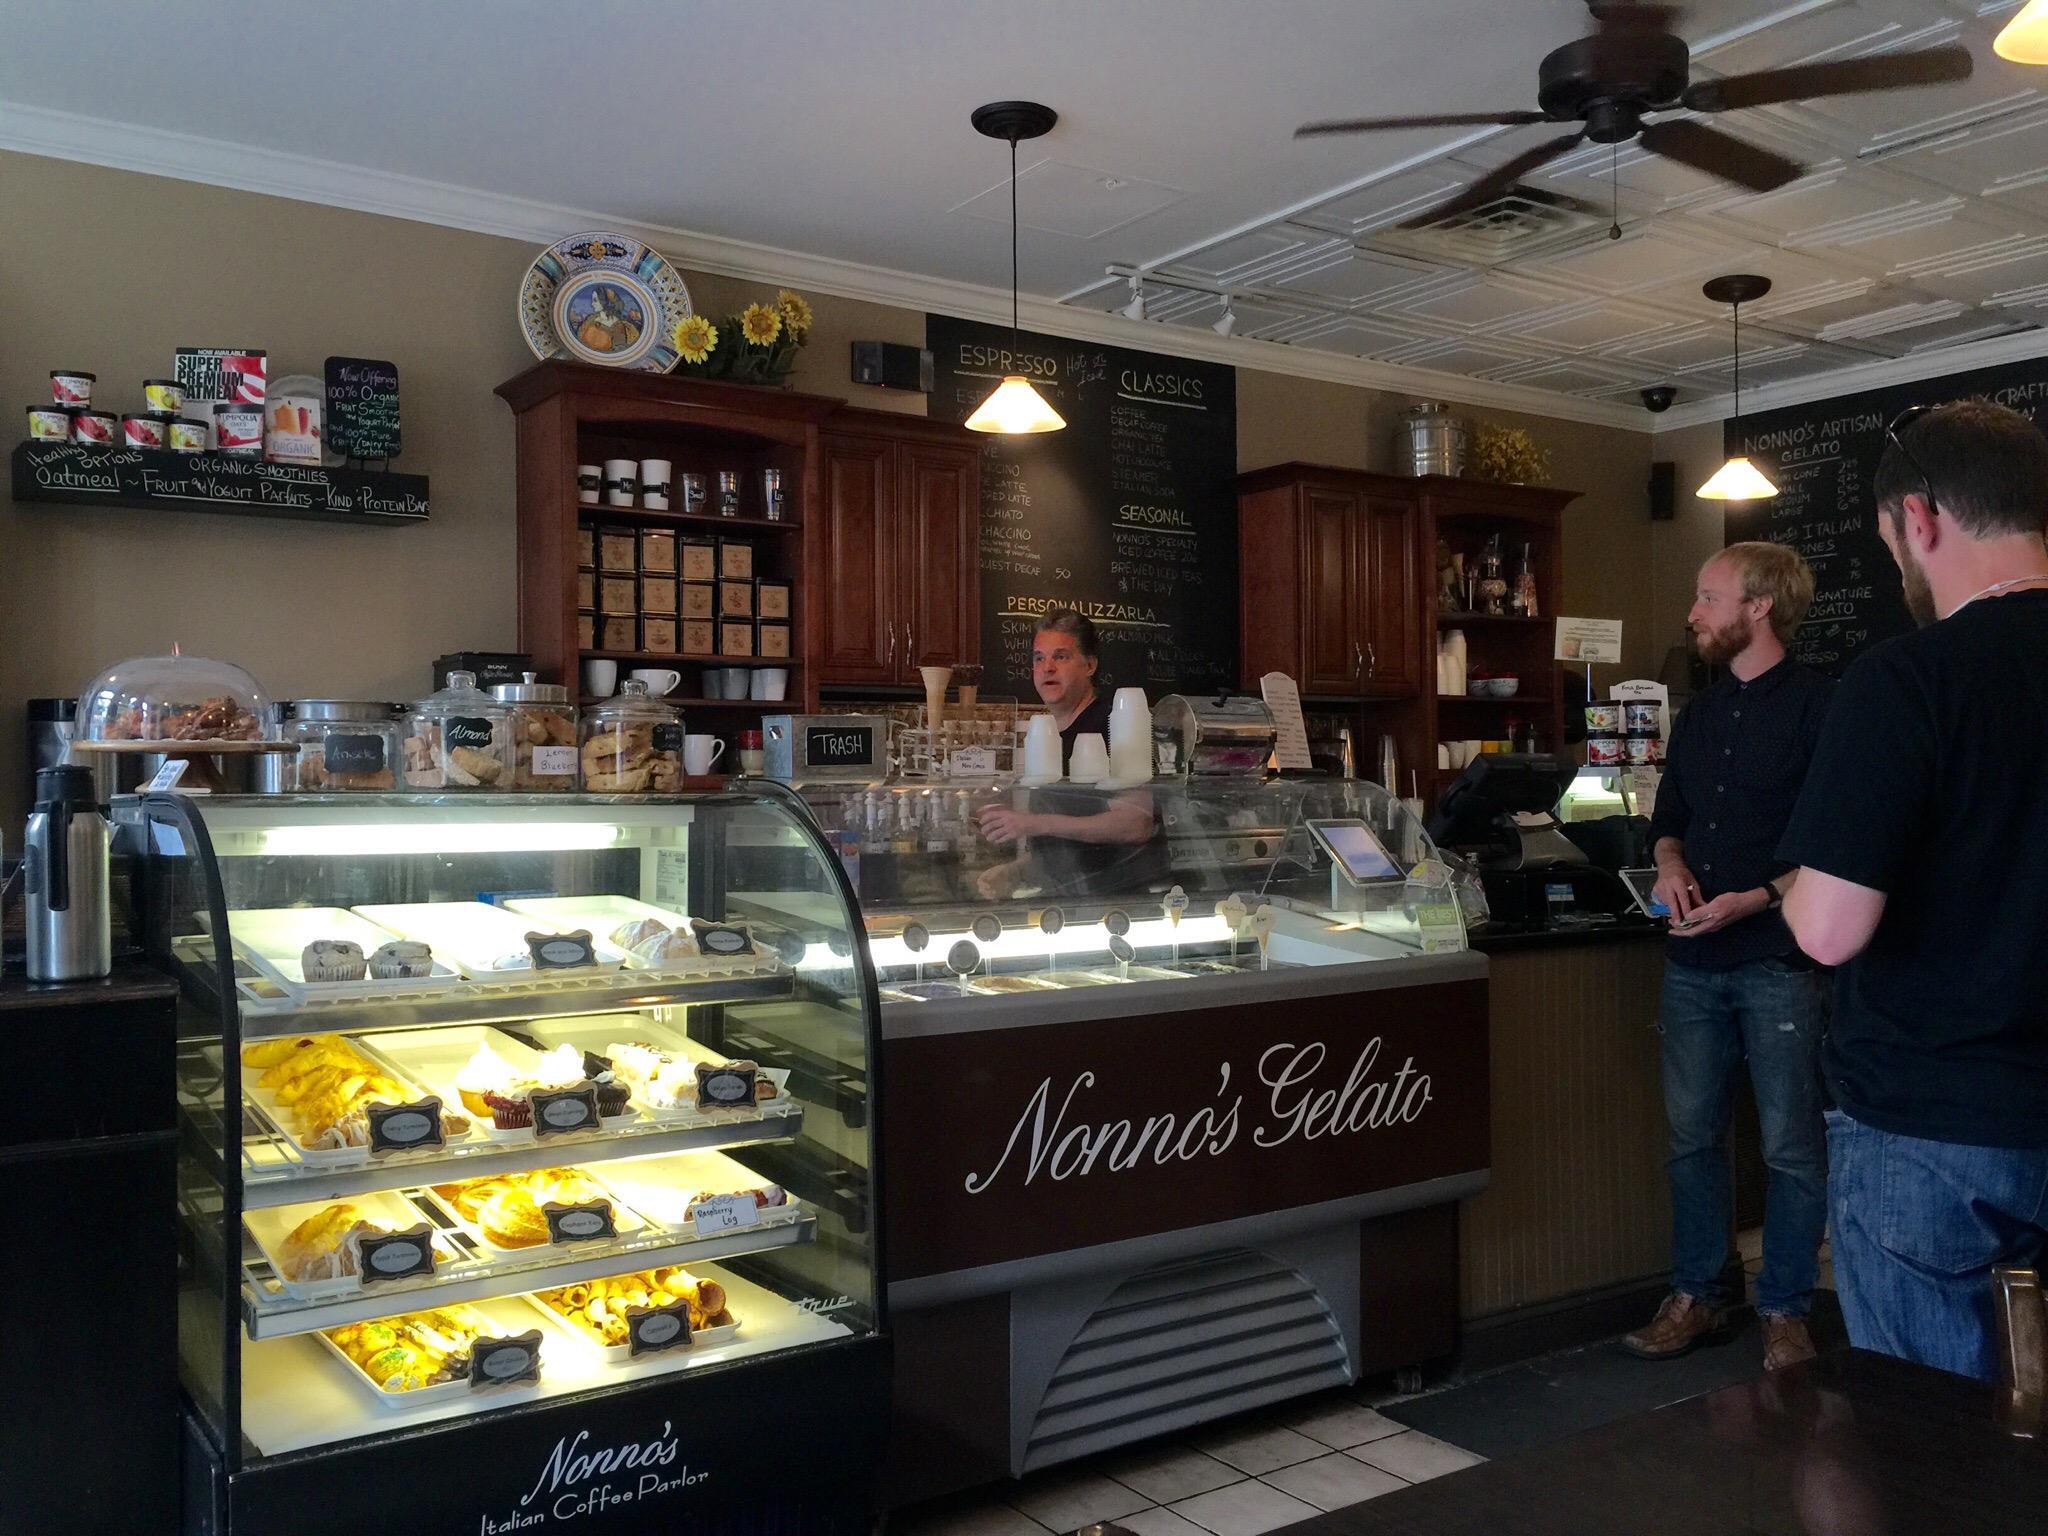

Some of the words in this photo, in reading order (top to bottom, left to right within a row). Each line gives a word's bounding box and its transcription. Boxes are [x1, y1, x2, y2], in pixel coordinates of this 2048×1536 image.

[177, 355, 222, 371] SUPER
[214, 349, 247, 357] AVAILABLE
[960, 343, 1057, 377] ESPRESSO
[177, 370, 244, 387] PREMIUM
[1120, 370, 1203, 400] CLASSICS
[184, 383, 238, 400] ATMEAL
[328, 385, 358, 400] 100%
[1744, 420, 1816, 454] NONNO'S
[1820, 411, 1884, 438] ARTISAN
[27, 446, 87, 467] Healthy
[272, 441, 316, 455] ORGANIC
[1780, 439, 1841, 462] GELATO
[35, 464, 119, 487] Oatmeal
[140, 469, 190, 492] FRUIT
[189, 457, 252, 476] ORGANIC
[253, 462, 329, 482] SMOOTHIES
[1119, 504, 1193, 528] SEASONAL
[1800, 517, 1863, 541] ITALIAN
[1007, 596, 1156, 622] PERSONALIZZARLA
[1000, 620, 1032, 635] SKIM
[1007, 666, 1033, 680] SHO
[449, 724, 490, 741] Almond
[812, 733, 864, 756] TRASH
[964, 1060, 1243, 1194] Nonno's
[1253, 1036, 1433, 1148] Gelato
[697, 1206, 733, 1218] Raspberry
[722, 1215, 738, 1226] Log
[519, 1420, 680, 1508] Nonno's
[479, 1510, 545, 1536] Italian
[552, 1483, 634, 1520] Coffee
[636, 1465, 710, 1500] Parlor
